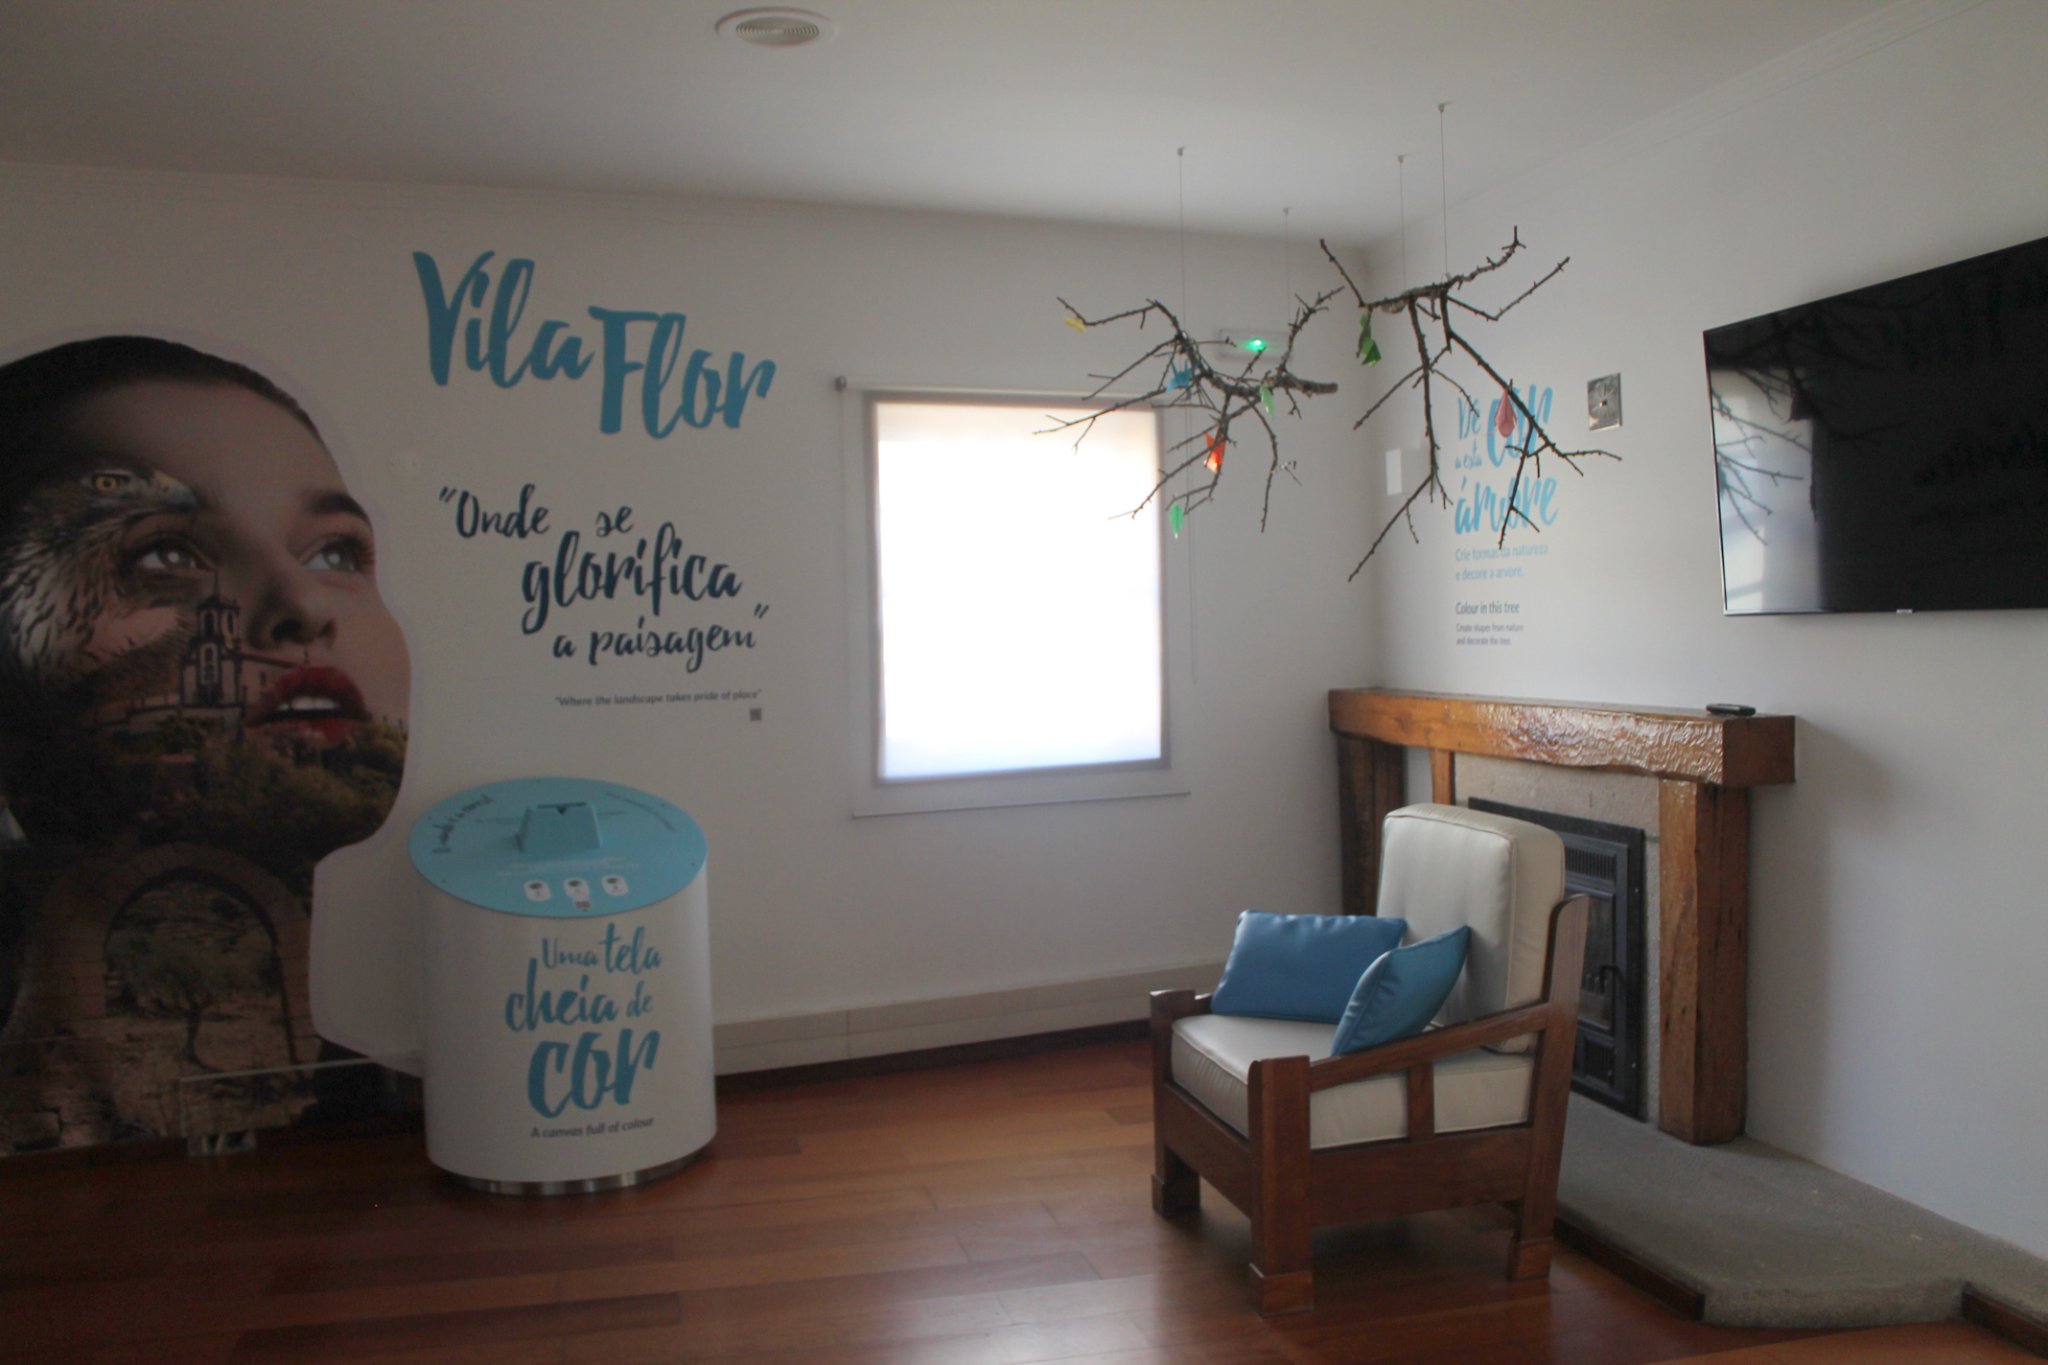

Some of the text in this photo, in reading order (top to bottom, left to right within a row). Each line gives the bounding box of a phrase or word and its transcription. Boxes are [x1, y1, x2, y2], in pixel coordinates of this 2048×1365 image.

[413, 250, 776, 440] Vila Flor
[595, 506, 633, 537] se
[521, 521, 742, 635] glorifica
[1456, 600, 1520, 615] Colour in this tree
[553, 634, 577, 657] a
[595, 695, 611, 705] the
[614, 694, 663, 705] landscape
[666, 692, 691, 702] takes
[694, 690, 719, 702] pride
[721, 690, 731, 700] of
[542, 922, 662, 975] Uma tela
[505, 957, 652, 1032] cheia de
[530, 1117, 655, 1139] A canvas full of colour
